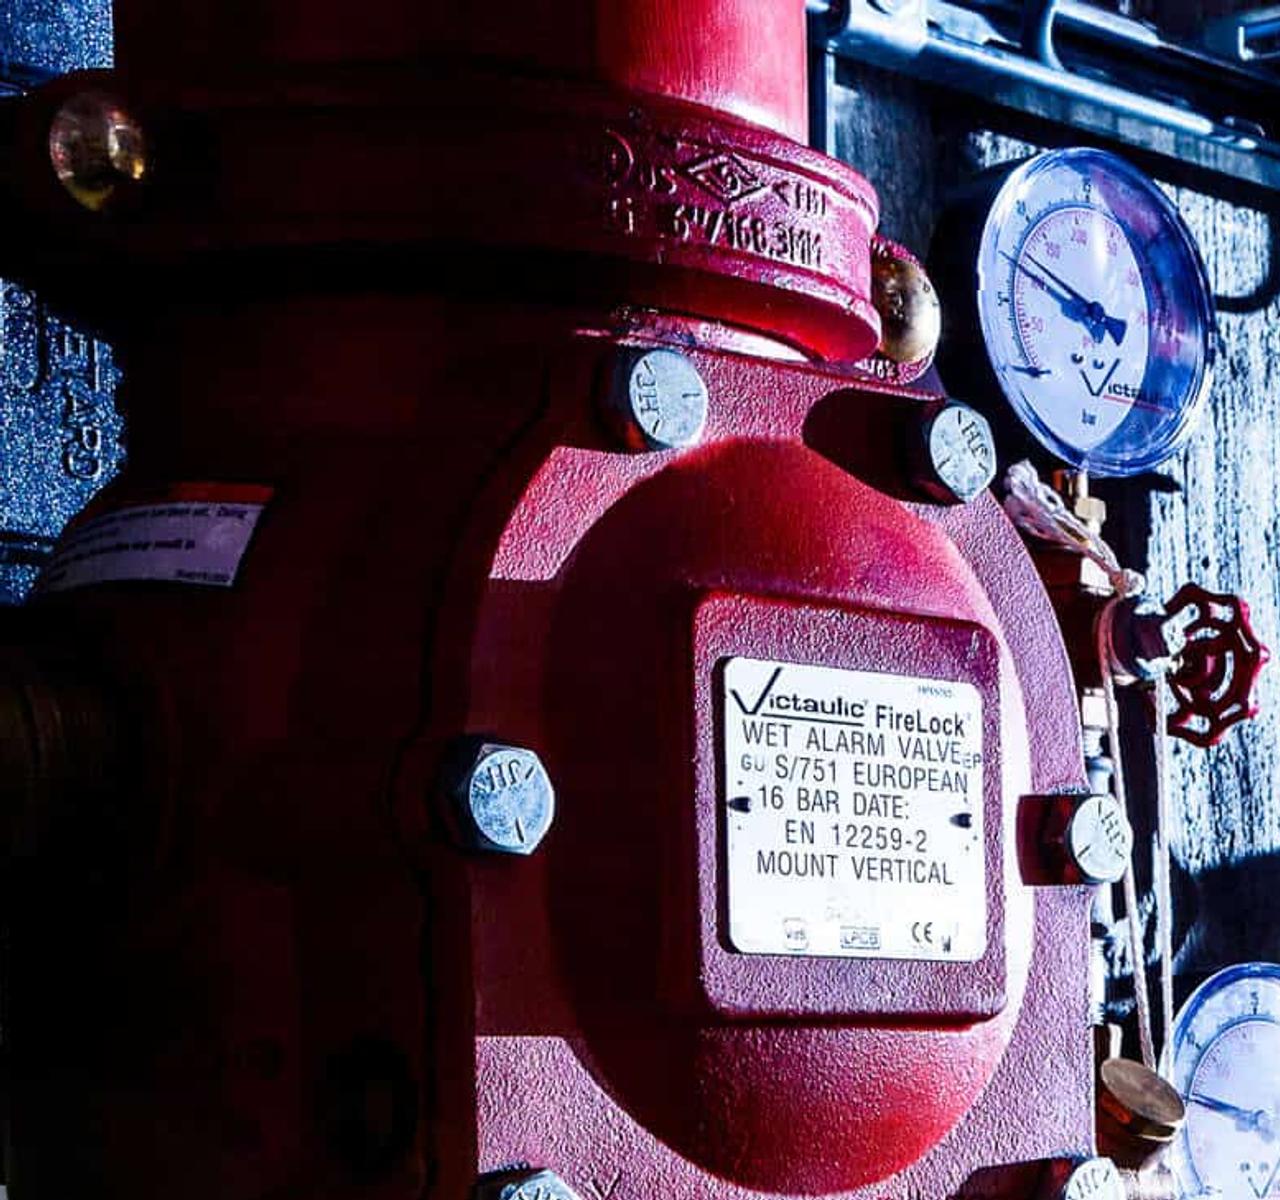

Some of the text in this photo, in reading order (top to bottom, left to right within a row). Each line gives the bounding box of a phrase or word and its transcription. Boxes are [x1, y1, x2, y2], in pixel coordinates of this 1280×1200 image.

[729, 666, 966, 738] Victaulic FireLock
[742, 719, 962, 765] WET ALARM VALVE
[775, 754, 968, 794] S/751 EUROPEAN
[758, 785, 910, 820] 16 BAR DATE:
[786, 820, 928, 852] EN 12259-2
[757, 850, 955, 885] MOUNT VERTICAL
